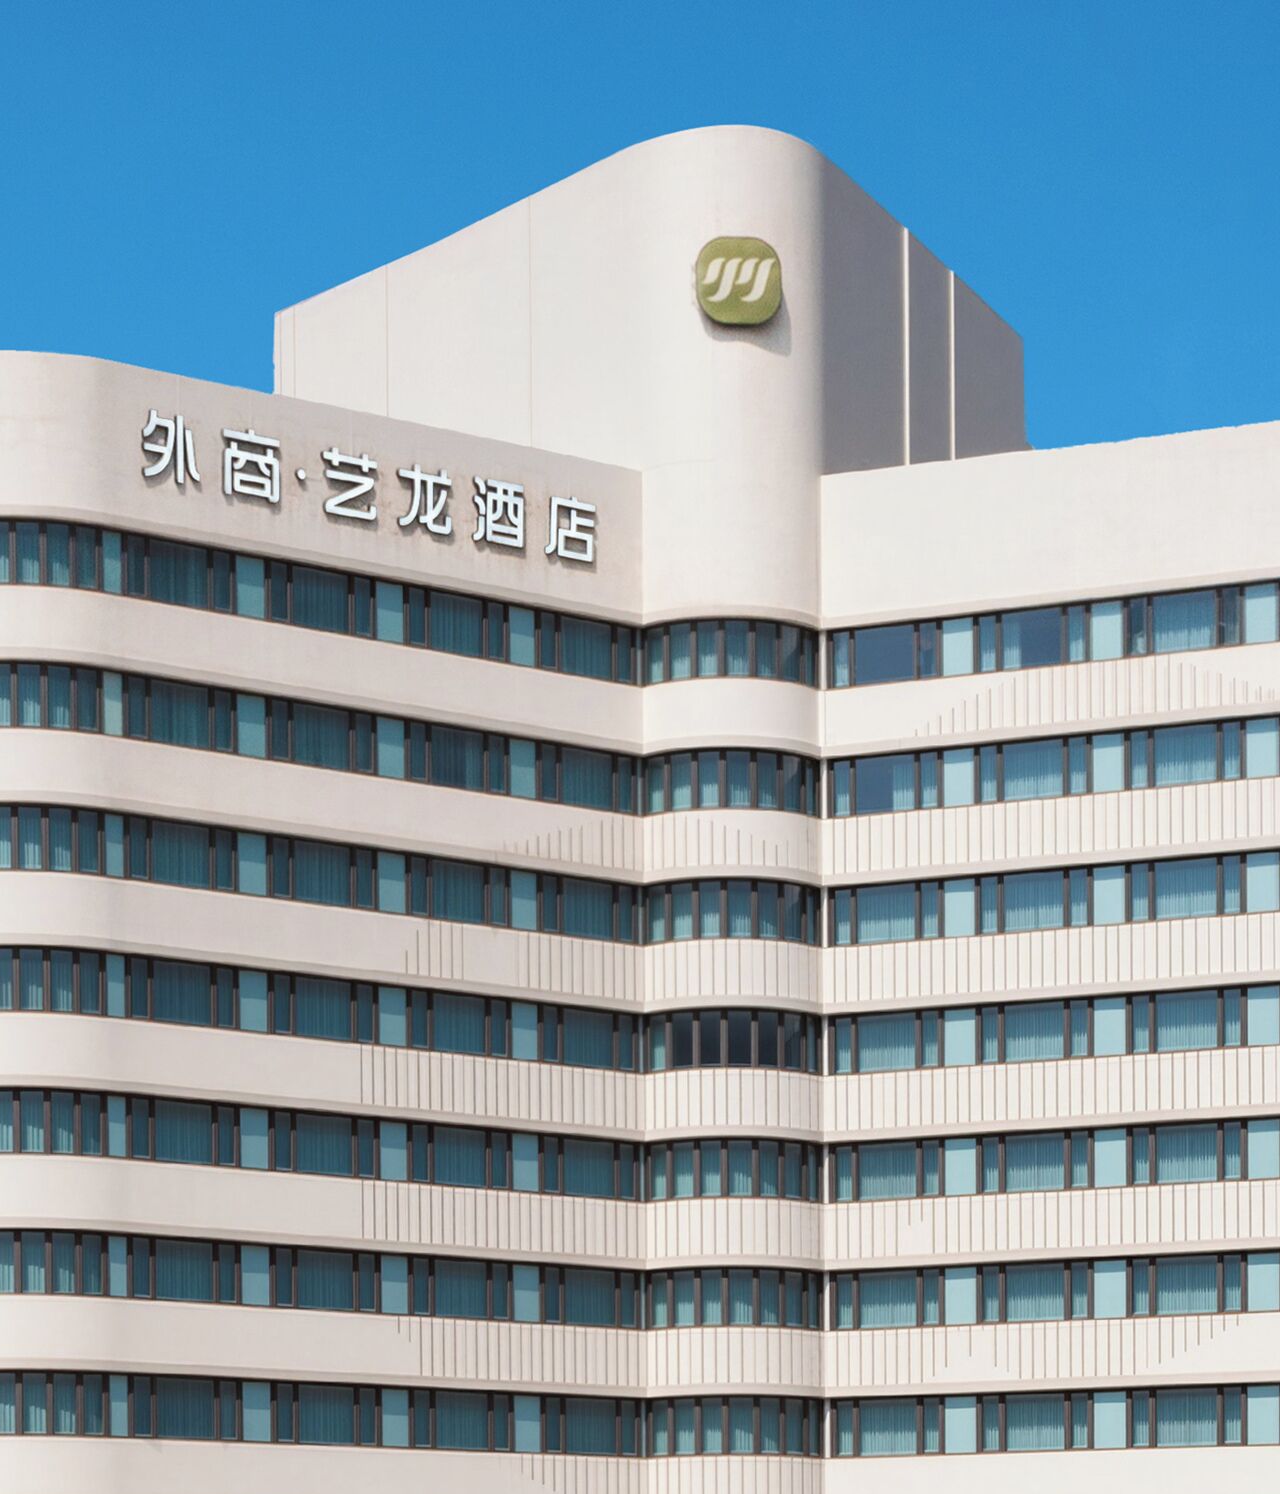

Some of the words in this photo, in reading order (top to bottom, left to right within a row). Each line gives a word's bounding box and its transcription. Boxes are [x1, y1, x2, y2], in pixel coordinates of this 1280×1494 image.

[141, 408, 597, 564] 外商·艺龙酒店
